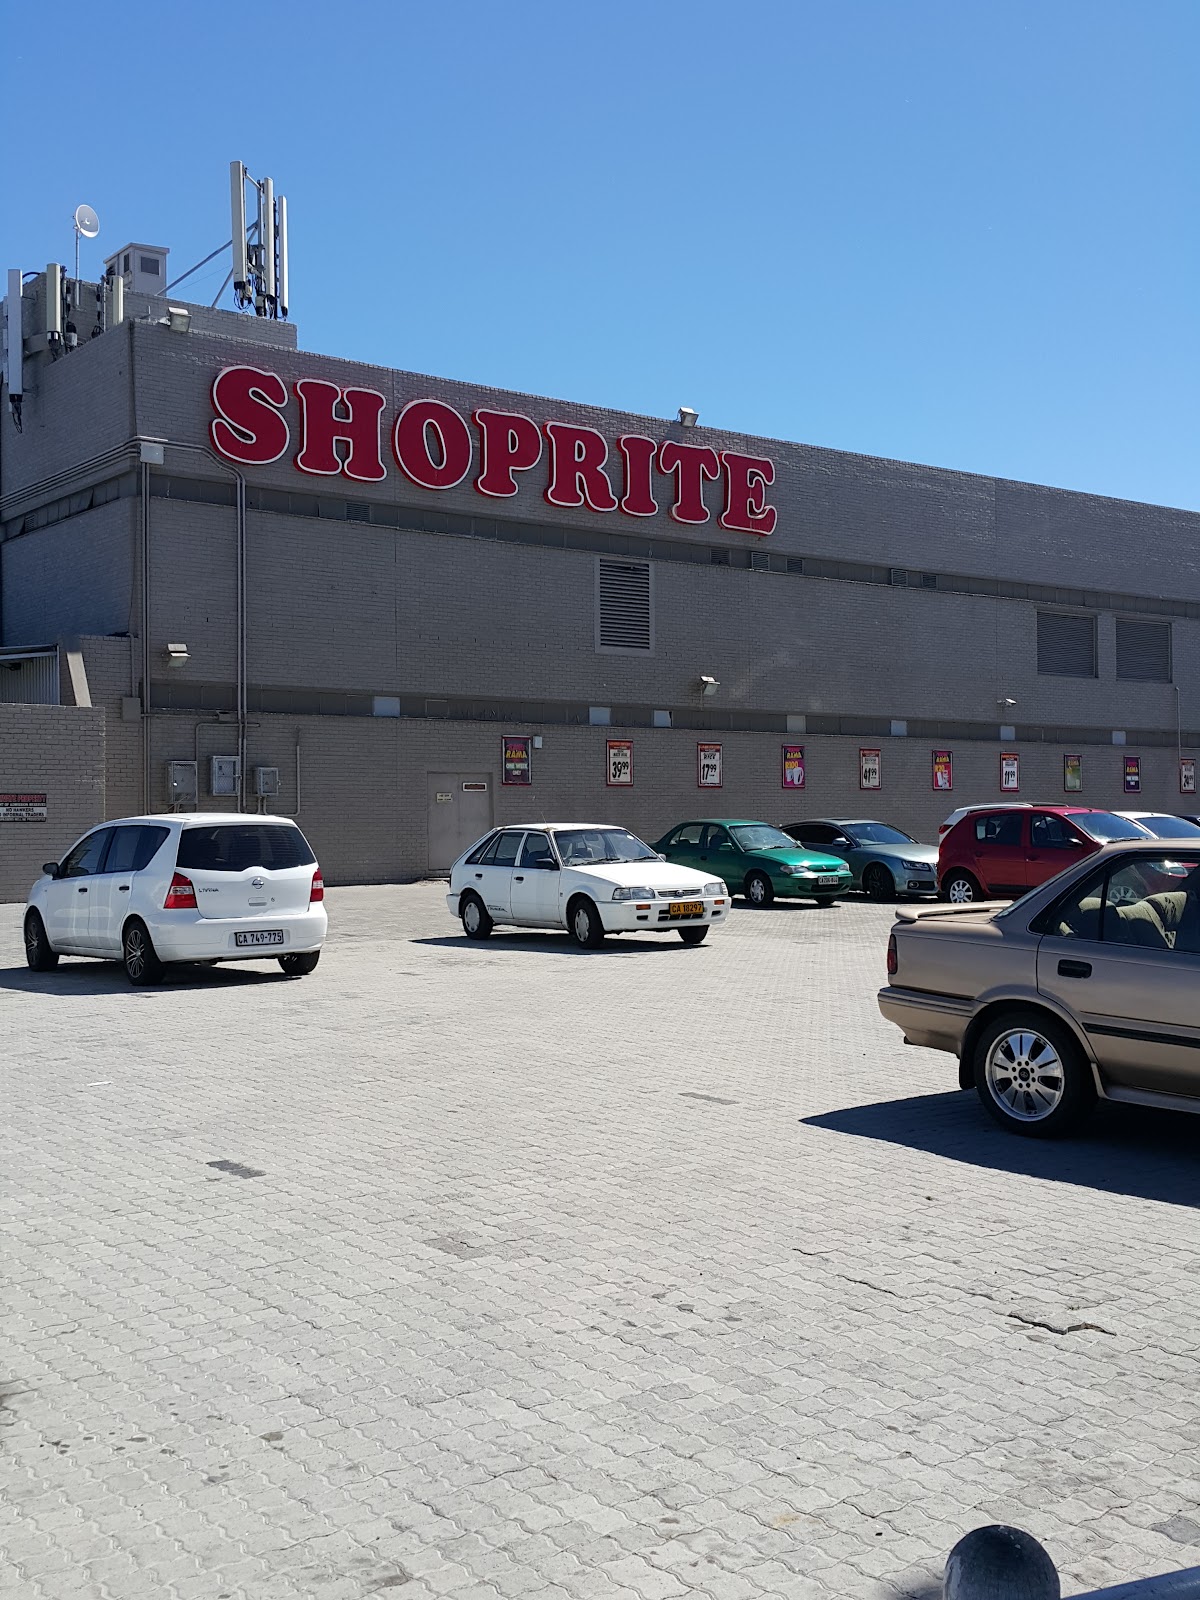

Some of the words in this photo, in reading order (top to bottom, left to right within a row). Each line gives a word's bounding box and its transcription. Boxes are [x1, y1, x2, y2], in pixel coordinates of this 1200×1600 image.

[209, 364, 779, 538] SHOPRITE
[671, 905, 681, 914] CA
[682, 903, 702, 913] 18297
[238, 933, 248, 944] CA
[250, 931, 282, 943] 749-775
